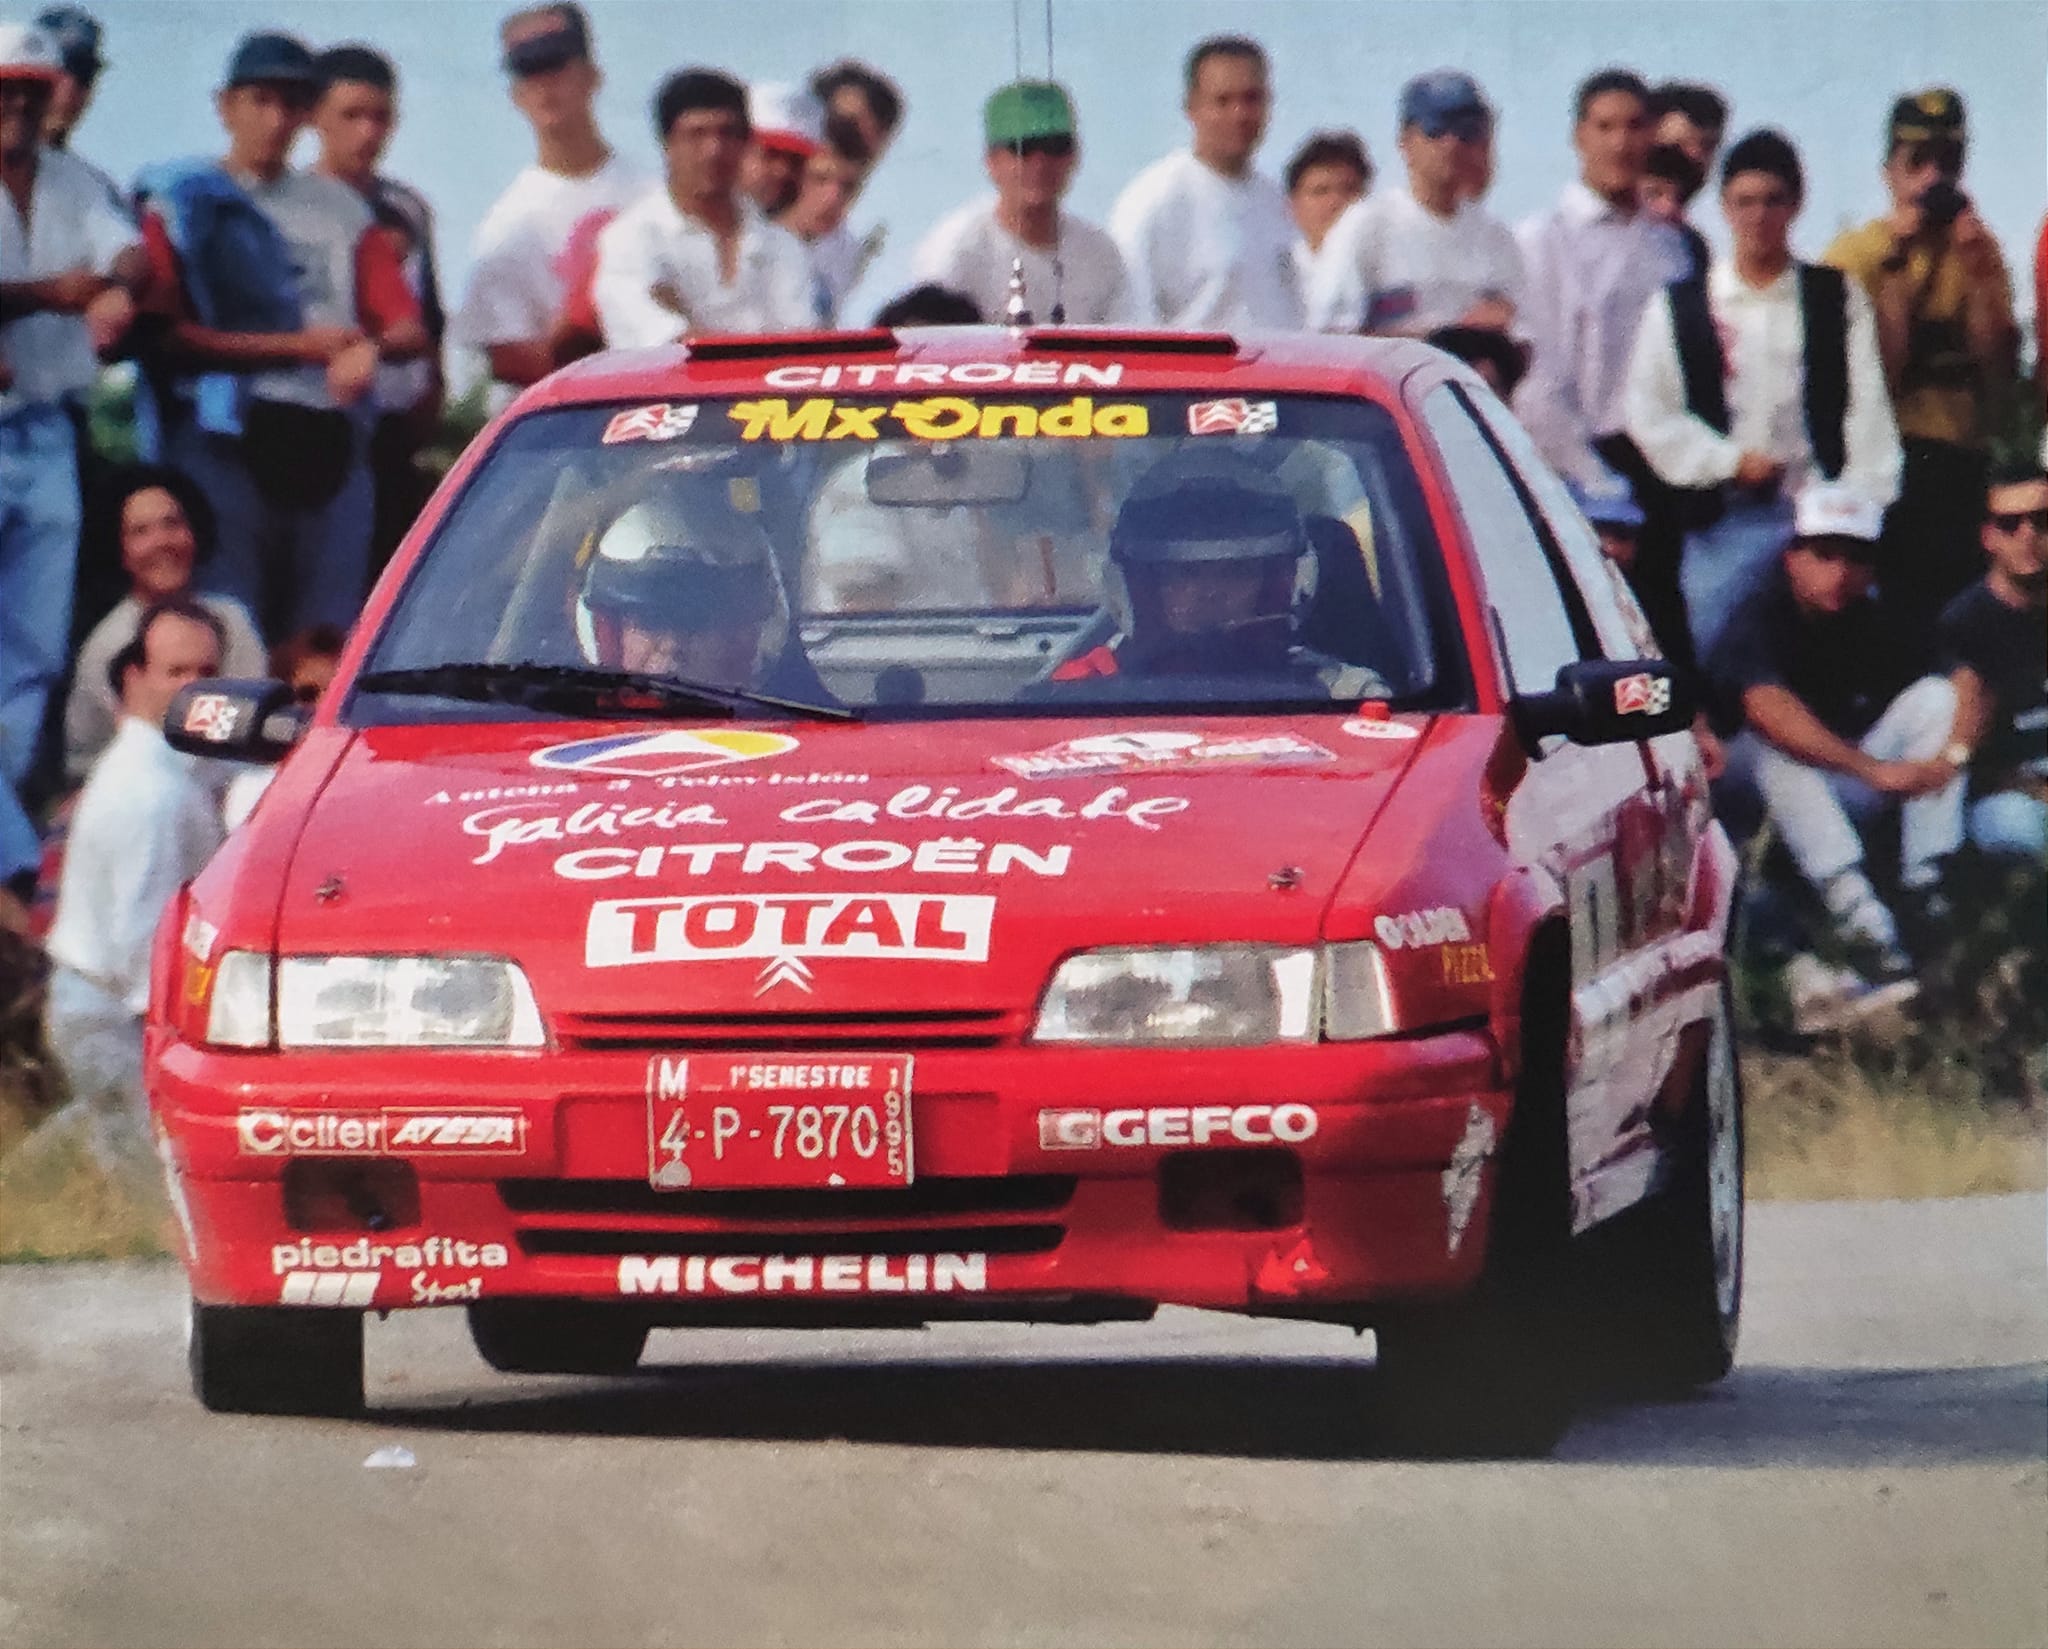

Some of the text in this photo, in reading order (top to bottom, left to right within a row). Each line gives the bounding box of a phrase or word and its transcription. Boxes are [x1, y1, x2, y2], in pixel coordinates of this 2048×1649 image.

[764, 360, 1124, 389] CITROËN
[463, 801, 728, 865] Galicia
[553, 837, 1072, 880] CITROËN
[614, 897, 969, 955] TOTAL
[660, 1058, 689, 1101] M
[1103, 1103, 1319, 1146] GEFCO
[272, 1236, 509, 1275] piedrafita
[618, 1252, 986, 1294] MICHELIN
